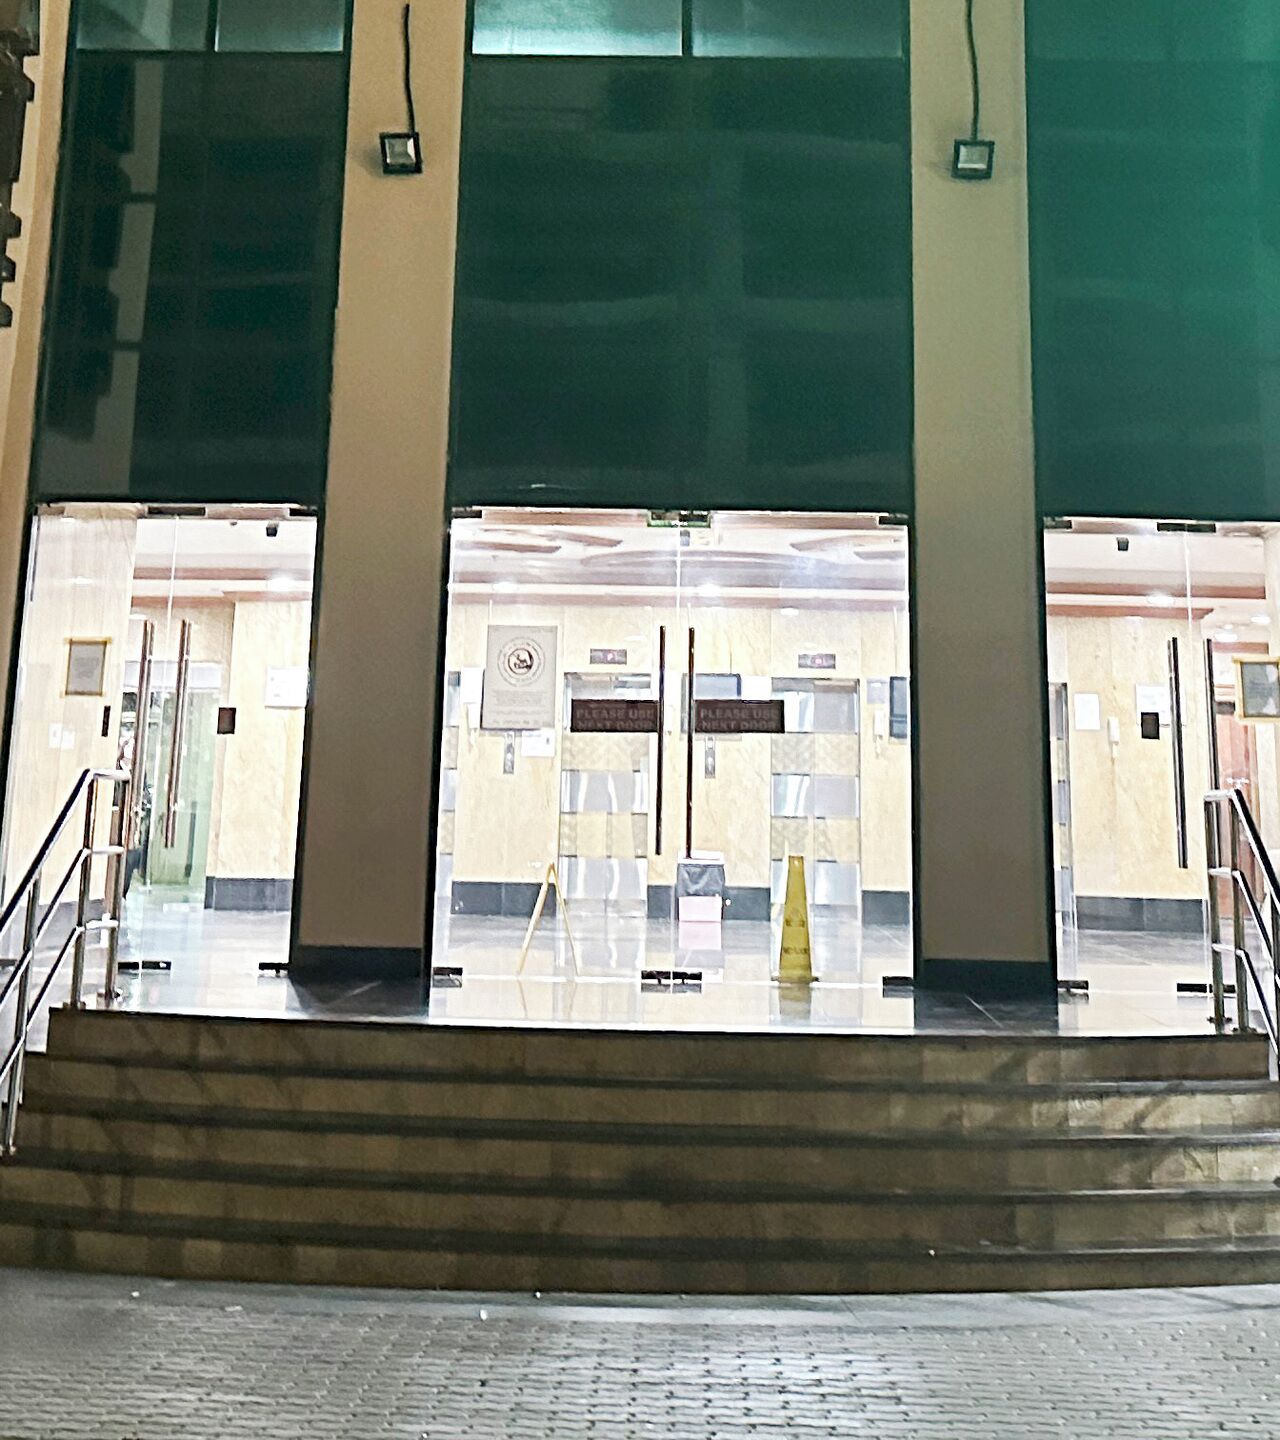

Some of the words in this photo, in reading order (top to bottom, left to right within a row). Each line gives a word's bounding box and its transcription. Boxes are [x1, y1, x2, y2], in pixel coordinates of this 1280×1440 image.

[576, 708, 626, 719] PLEASE
[701, 708, 750, 719] PLEASE
[702, 720, 738, 730] NEXT
